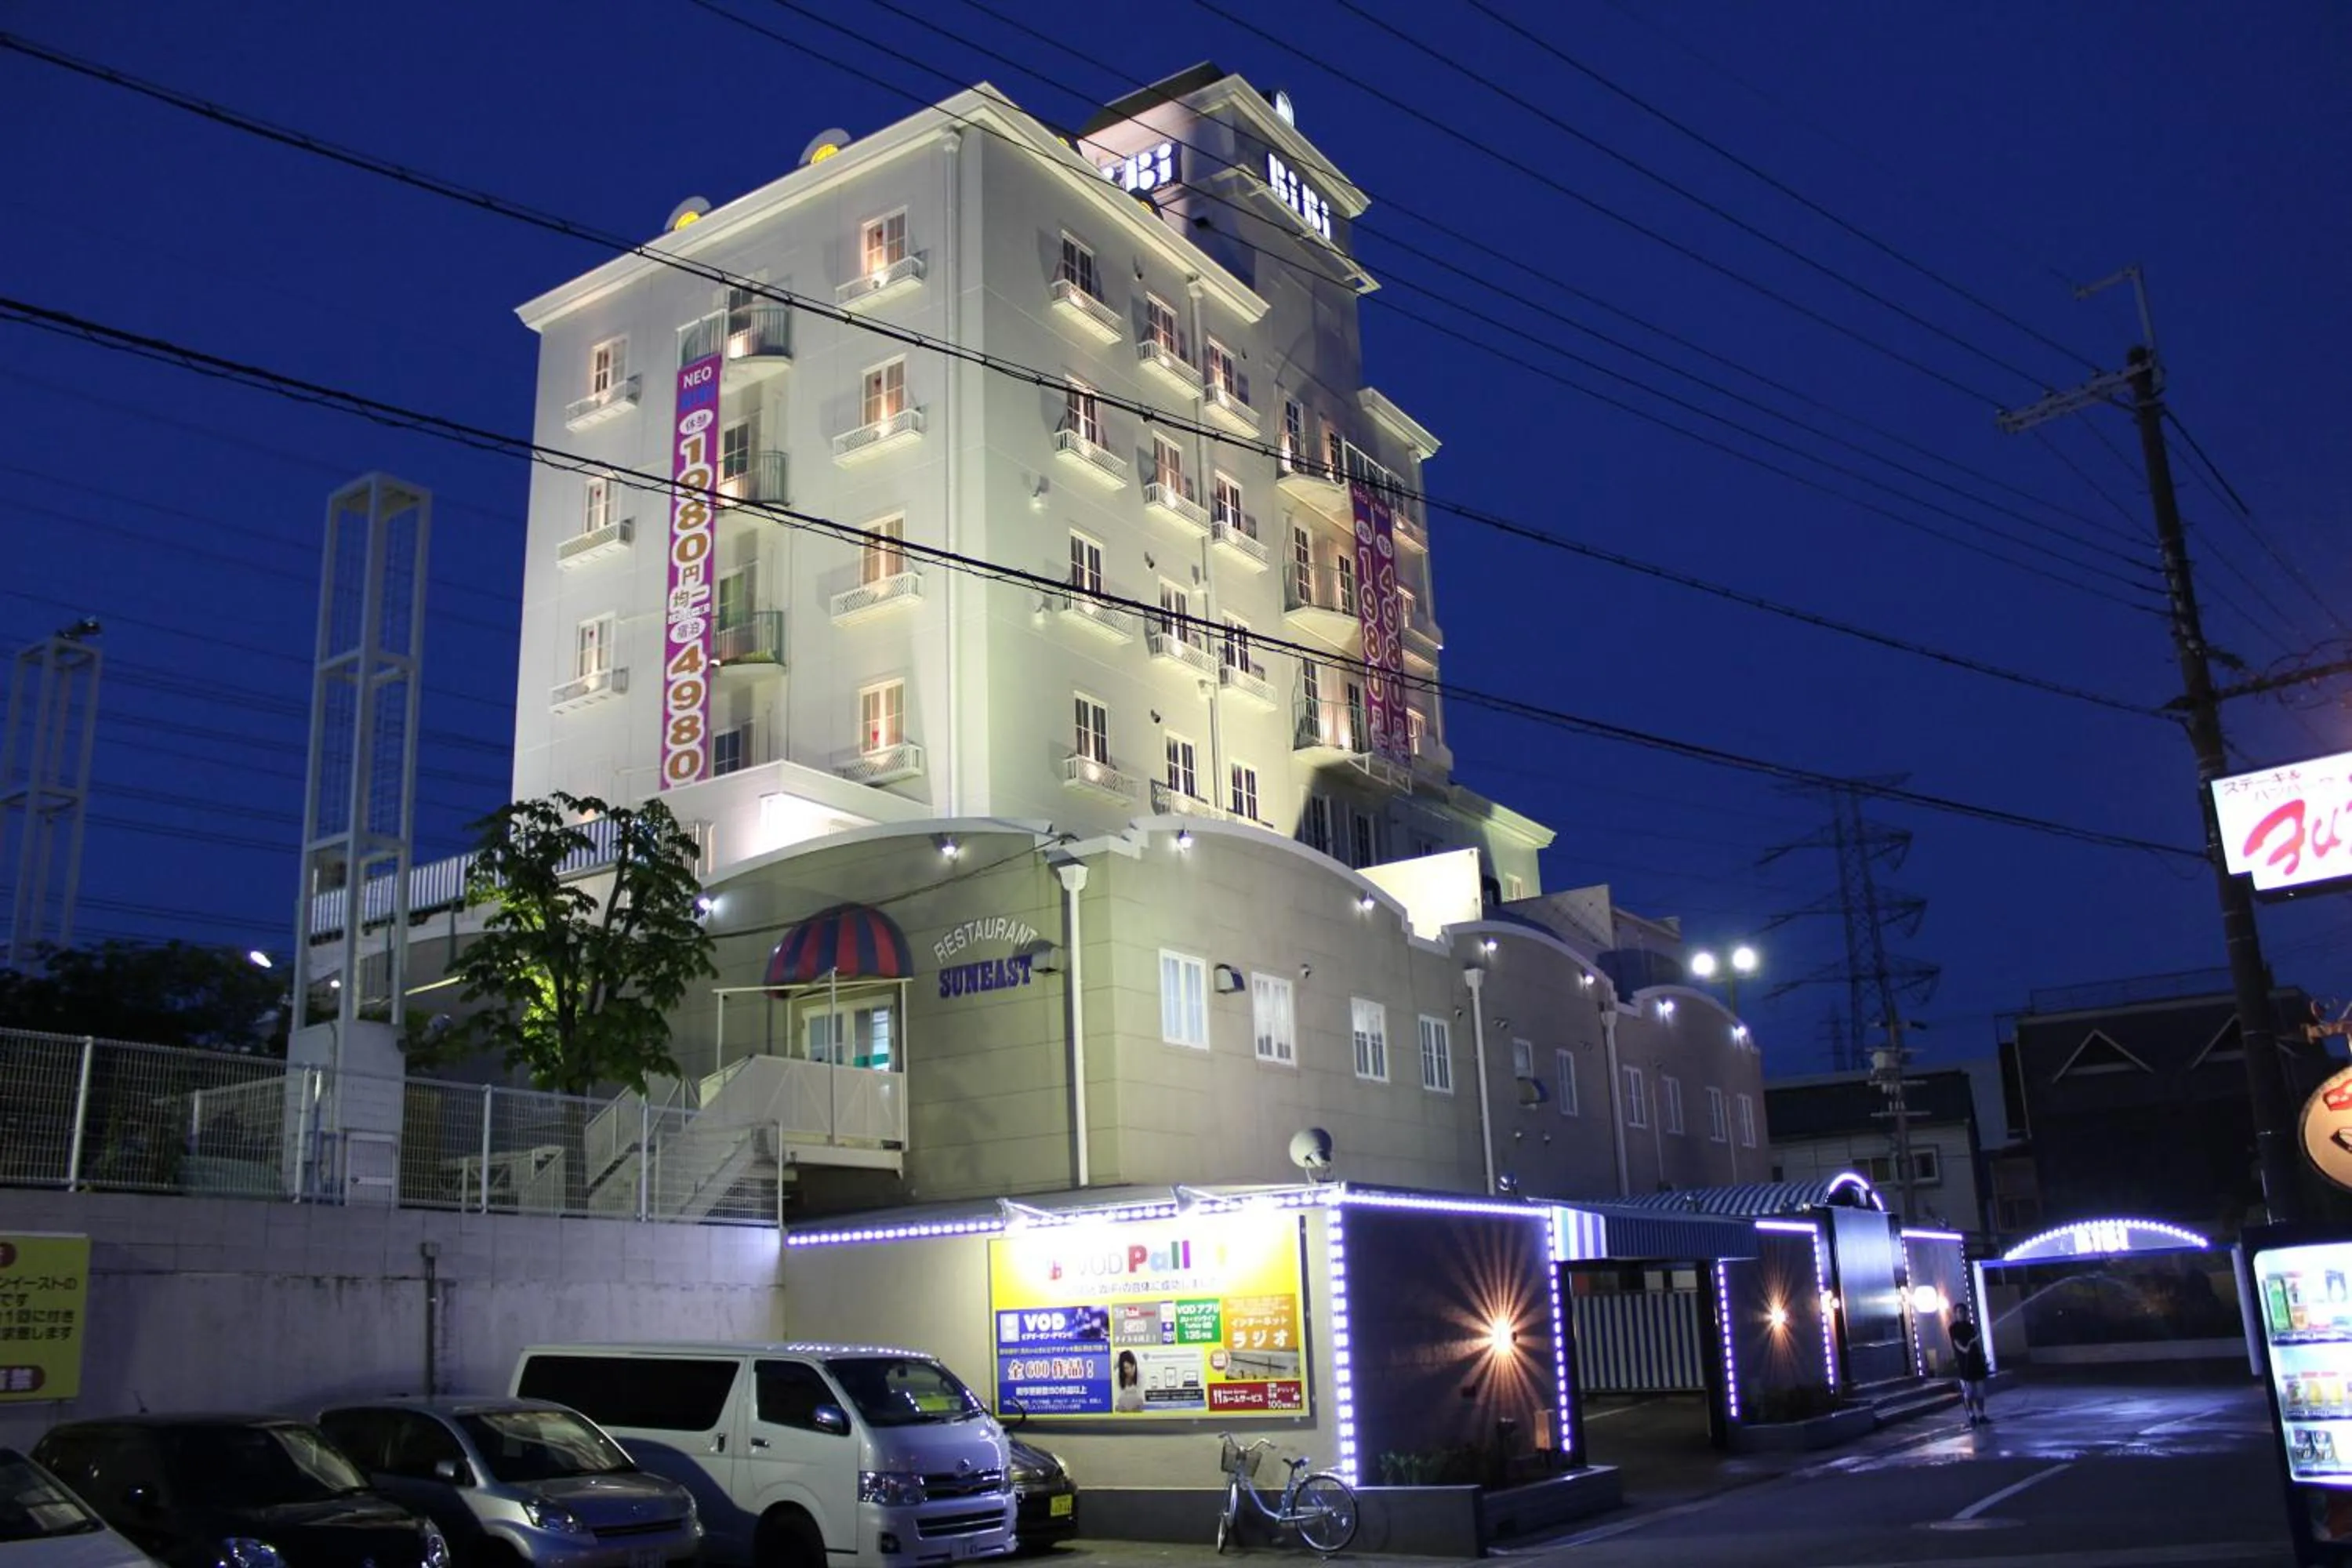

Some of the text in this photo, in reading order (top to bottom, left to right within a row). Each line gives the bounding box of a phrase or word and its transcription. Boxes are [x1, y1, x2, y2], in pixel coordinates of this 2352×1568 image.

[683, 365, 712, 389] NEO
[934, 917, 1038, 963] RESTAURANT
[1023, 1312, 1065, 1332] VOD
[1232, 1329, 1289, 1348] ラジオ
